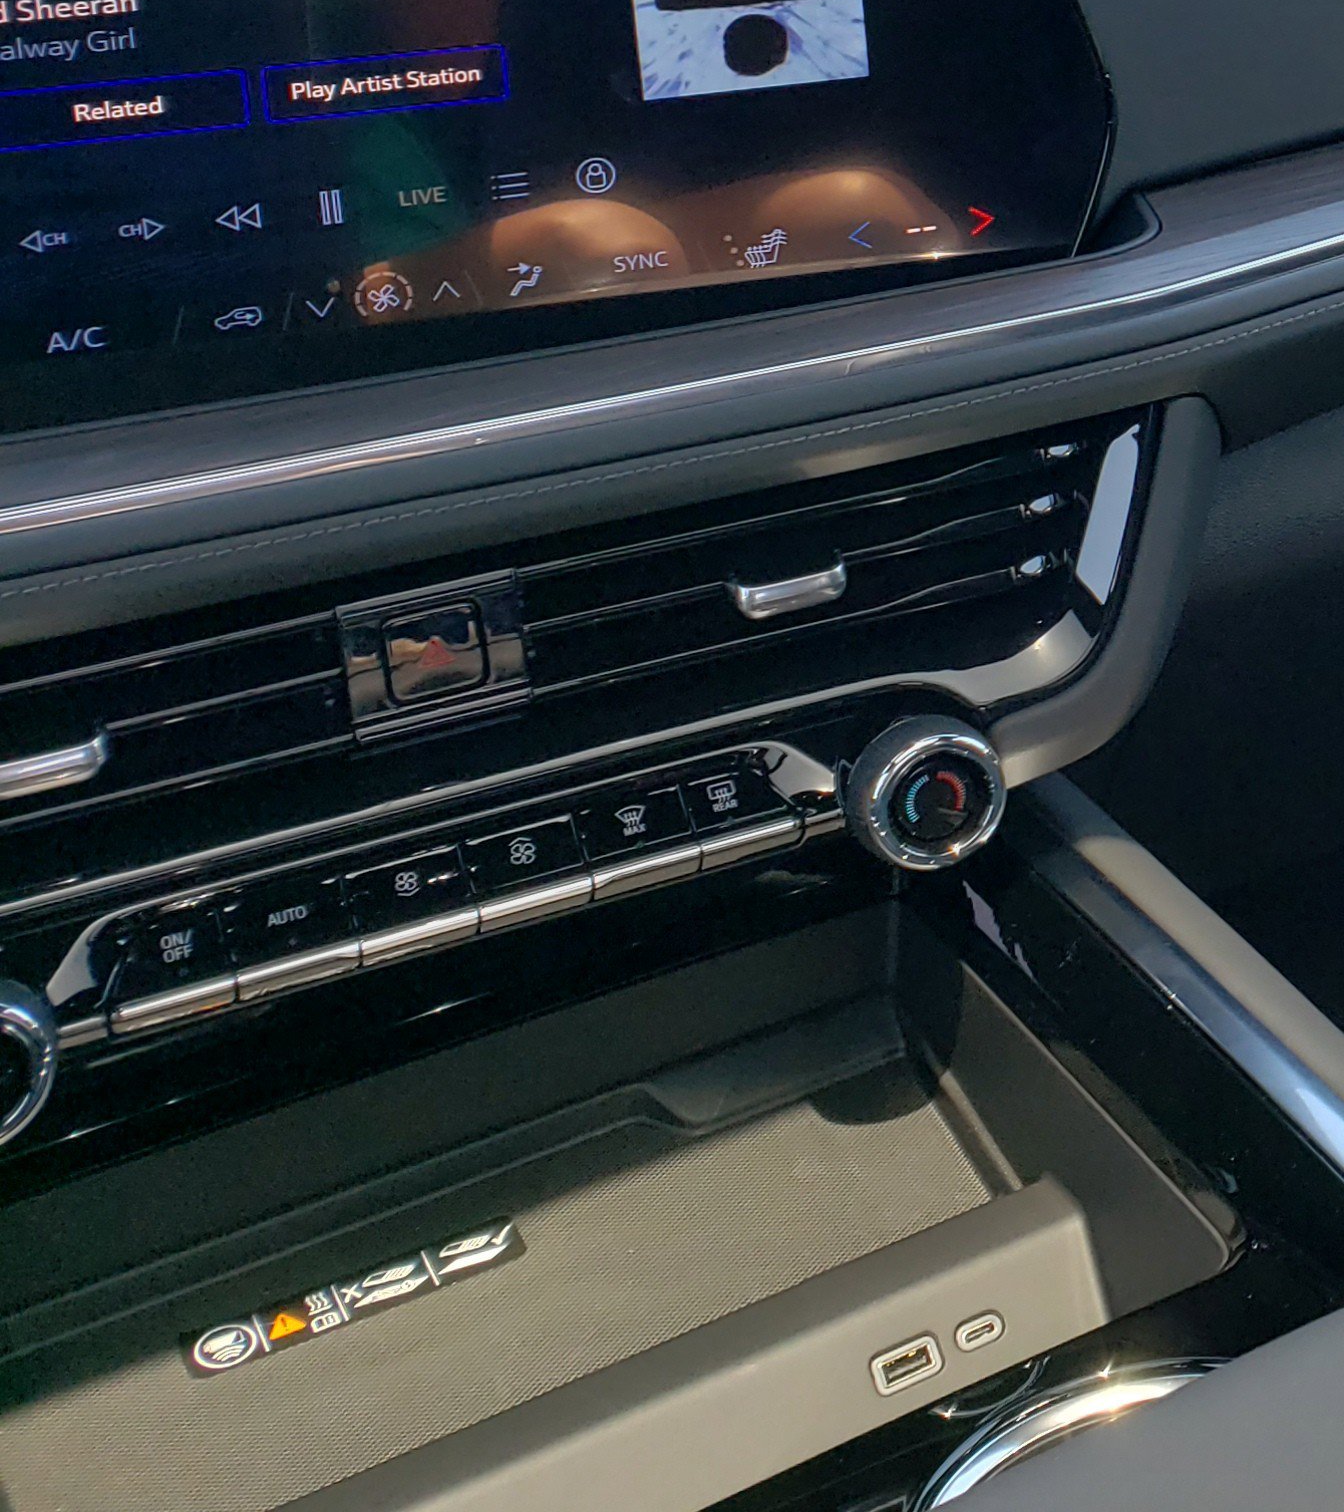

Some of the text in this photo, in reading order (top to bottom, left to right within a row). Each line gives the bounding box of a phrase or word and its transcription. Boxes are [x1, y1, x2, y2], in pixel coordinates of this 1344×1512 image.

[87, 27, 138, 53] Girl
[290, 67, 482, 103] Play Artist Station
[72, 95, 165, 123] Related
[399, 186, 446, 207] LIVE
[613, 251, 669, 273] SYNC
[46, 326, 107, 354] A/C
[712, 798, 739, 813] REAR
[622, 822, 647, 837] MAX
[266, 905, 308, 928] AUTO
[162, 944, 194, 964] OFF
